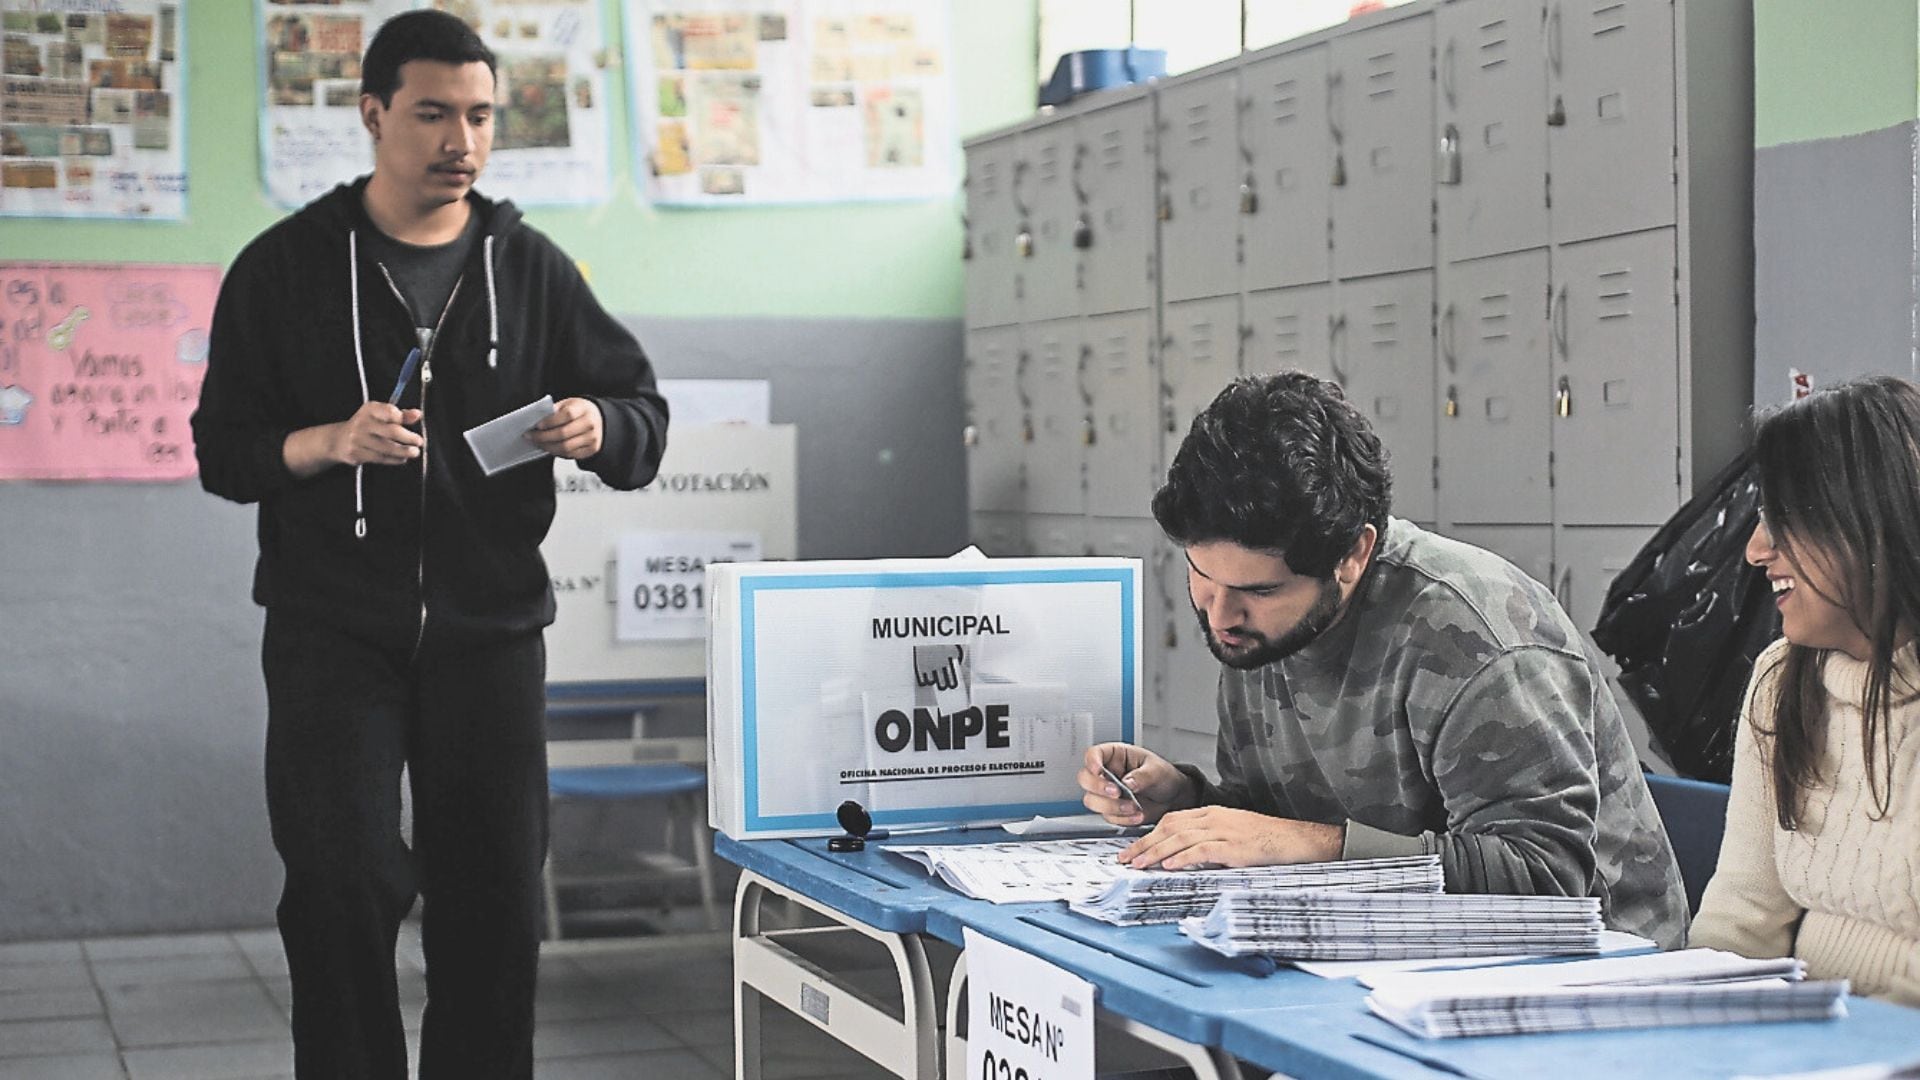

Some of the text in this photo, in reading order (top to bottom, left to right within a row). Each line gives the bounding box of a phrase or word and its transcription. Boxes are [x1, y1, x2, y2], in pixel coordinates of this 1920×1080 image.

[646, 556, 705, 574] MESA
[633, 583, 704, 610] 0381
[873, 615, 1010, 638] MUNICIPAL
[875, 704, 1010, 752] ONPE
[840, 760, 1045, 779] OFICINA NACIONAL DE PROCESOS ELECTORALES
[989, 991, 1043, 1053] MESA
